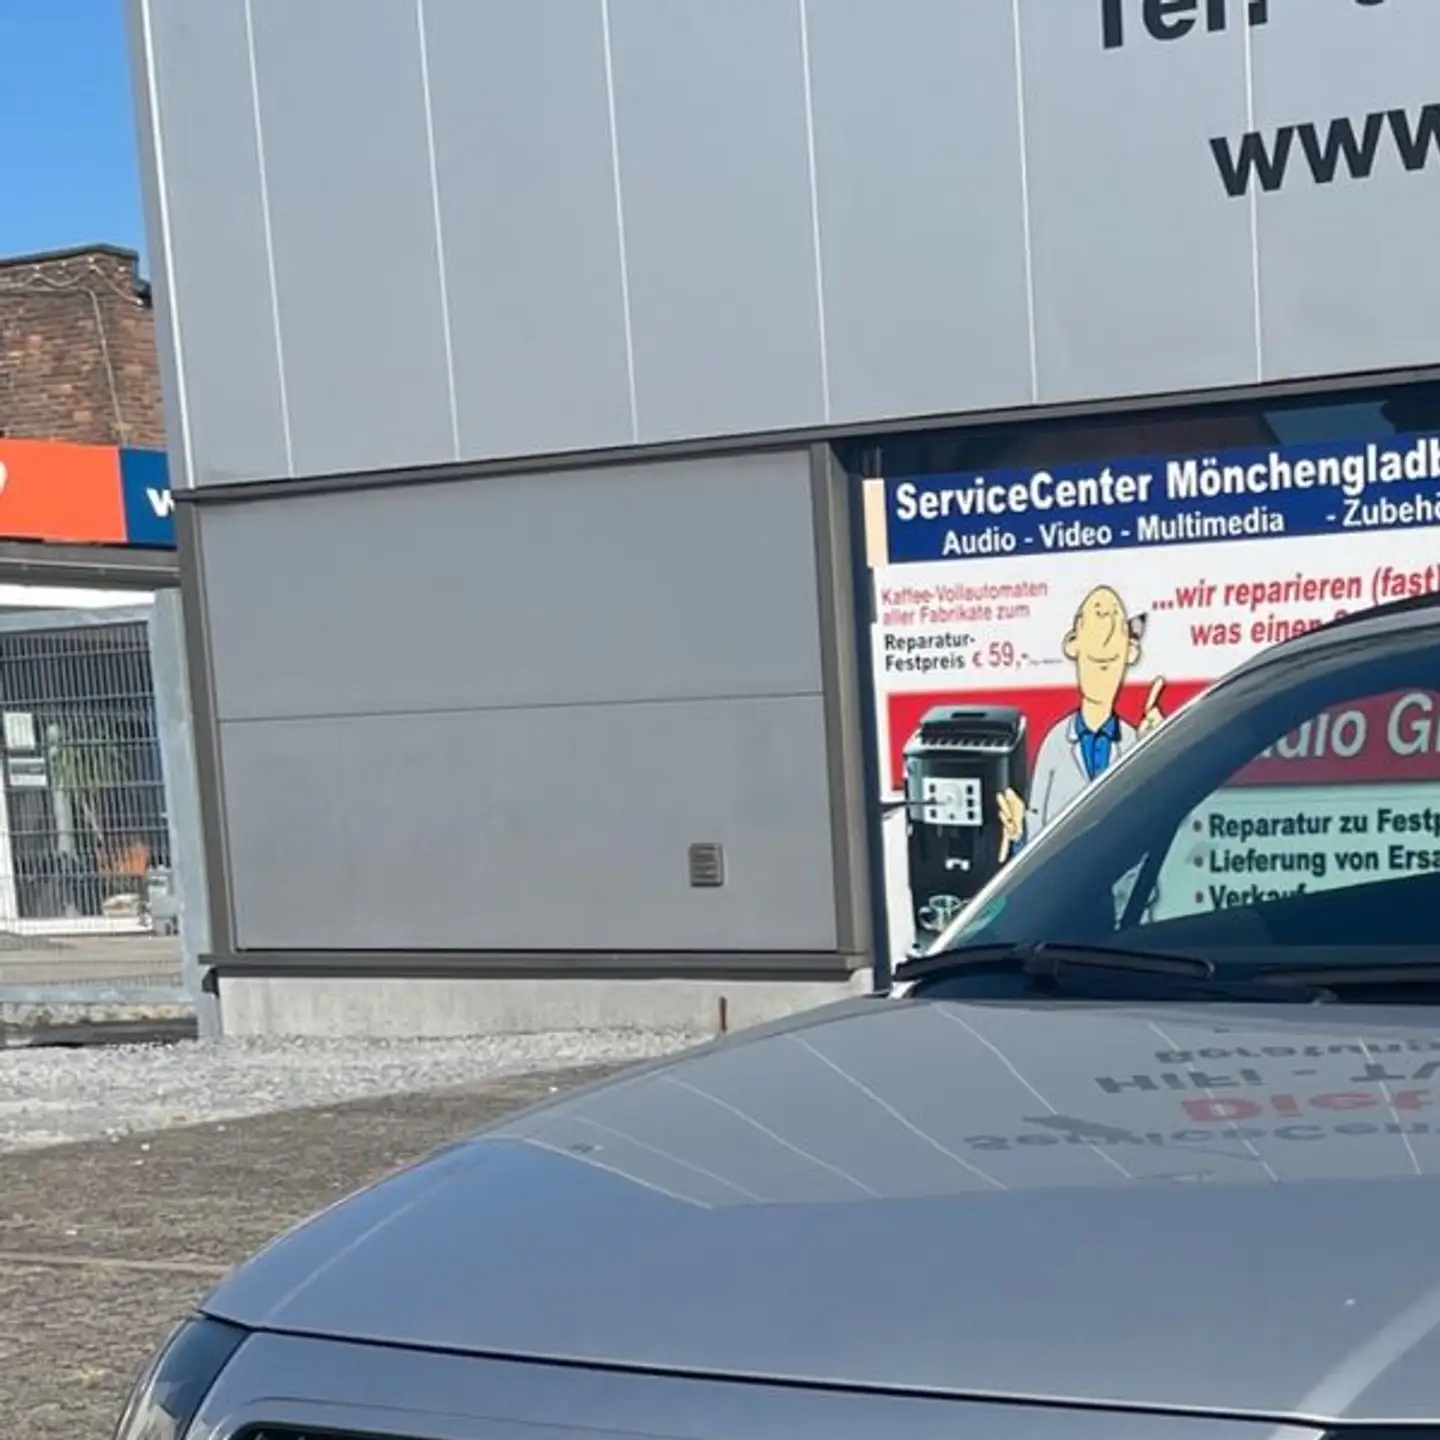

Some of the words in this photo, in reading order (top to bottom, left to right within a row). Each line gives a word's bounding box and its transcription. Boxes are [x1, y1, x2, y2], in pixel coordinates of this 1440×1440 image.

[896, 466, 1152, 520] ServiceCenter
[942, 526, 1017, 556] Audio
[1038, 520, 1112, 549] Video
[1137, 506, 1285, 542] Multimedia
[1223, 573, 1363, 613] reparieren
[919, 604, 993, 623] Fabrikate
[997, 605, 1030, 619] zum
[884, 631, 976, 654] Reparatur-
[1190, 621, 1242, 646] was
[885, 652, 966, 673] Festpreis
[1208, 811, 1333, 842] Reparatur
[1339, 814, 1368, 834] zu
[1208, 848, 1327, 877] Lieferung
[1334, 851, 1379, 871] von
